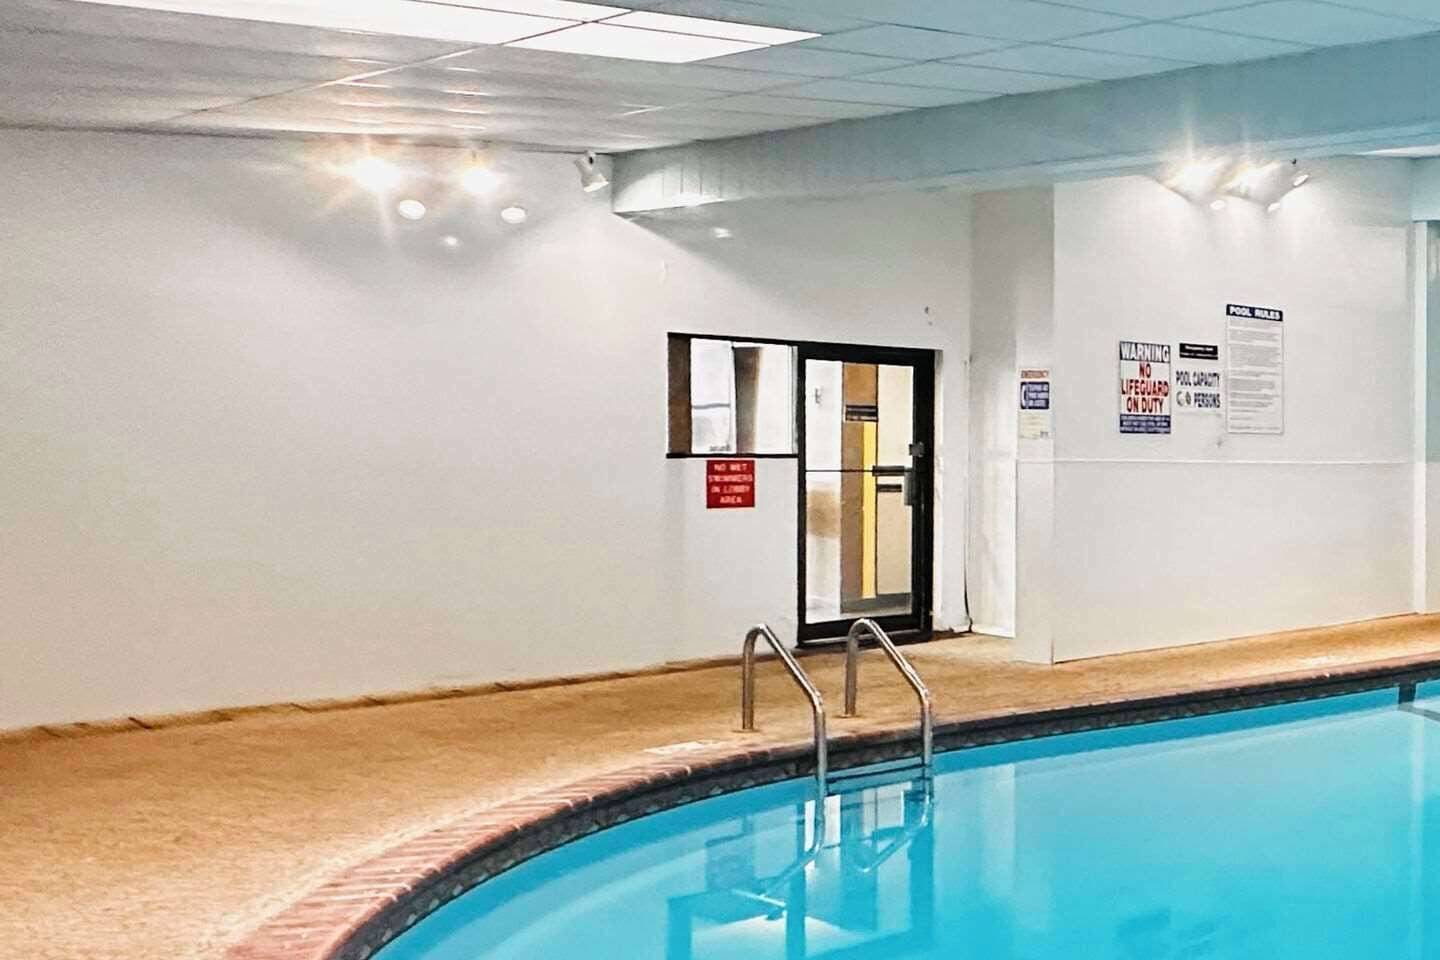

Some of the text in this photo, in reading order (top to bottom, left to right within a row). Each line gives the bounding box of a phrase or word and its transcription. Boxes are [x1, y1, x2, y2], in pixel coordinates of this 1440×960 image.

[1230, 305, 1281, 320] POOL RULES
[1120, 342, 1169, 362] WARNING
[1139, 363, 1152, 378] NO
[1176, 370, 1220, 388] POOL CAPACITY
[1121, 379, 1169, 397] LIFEGUARD
[1127, 396, 1164, 413] ON DUTY
[1194, 392, 1220, 408] PERSONS
[714, 463, 747, 472] NO WET
[720, 496, 742, 504] AREA
